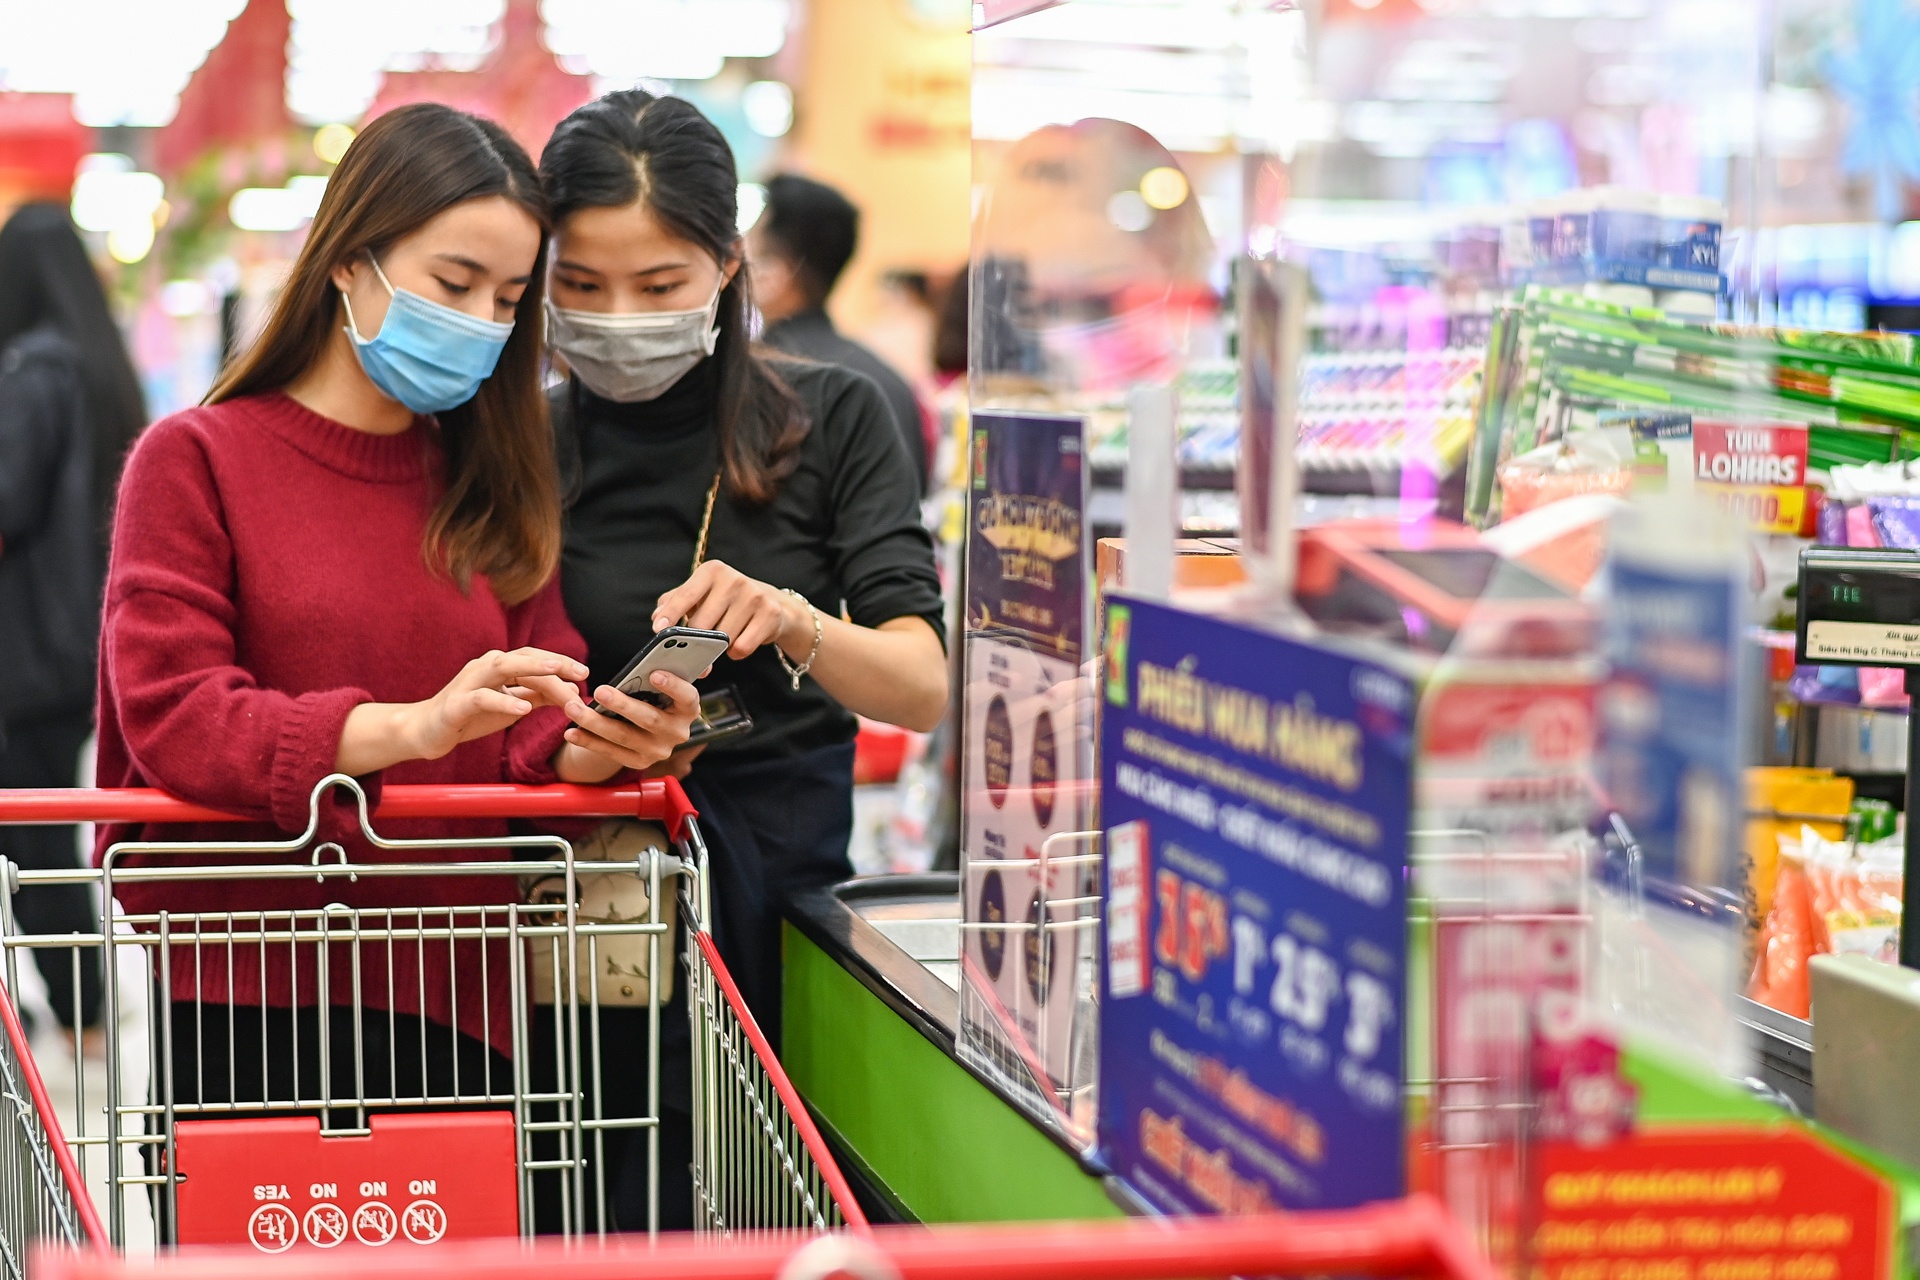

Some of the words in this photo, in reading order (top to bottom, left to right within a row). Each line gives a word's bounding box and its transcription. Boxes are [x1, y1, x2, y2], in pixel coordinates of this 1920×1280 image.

[253, 1185, 291, 1200] YES
[309, 1183, 338, 1198] NO
[359, 1182, 388, 1197] NO
[408, 1180, 437, 1195] NO
